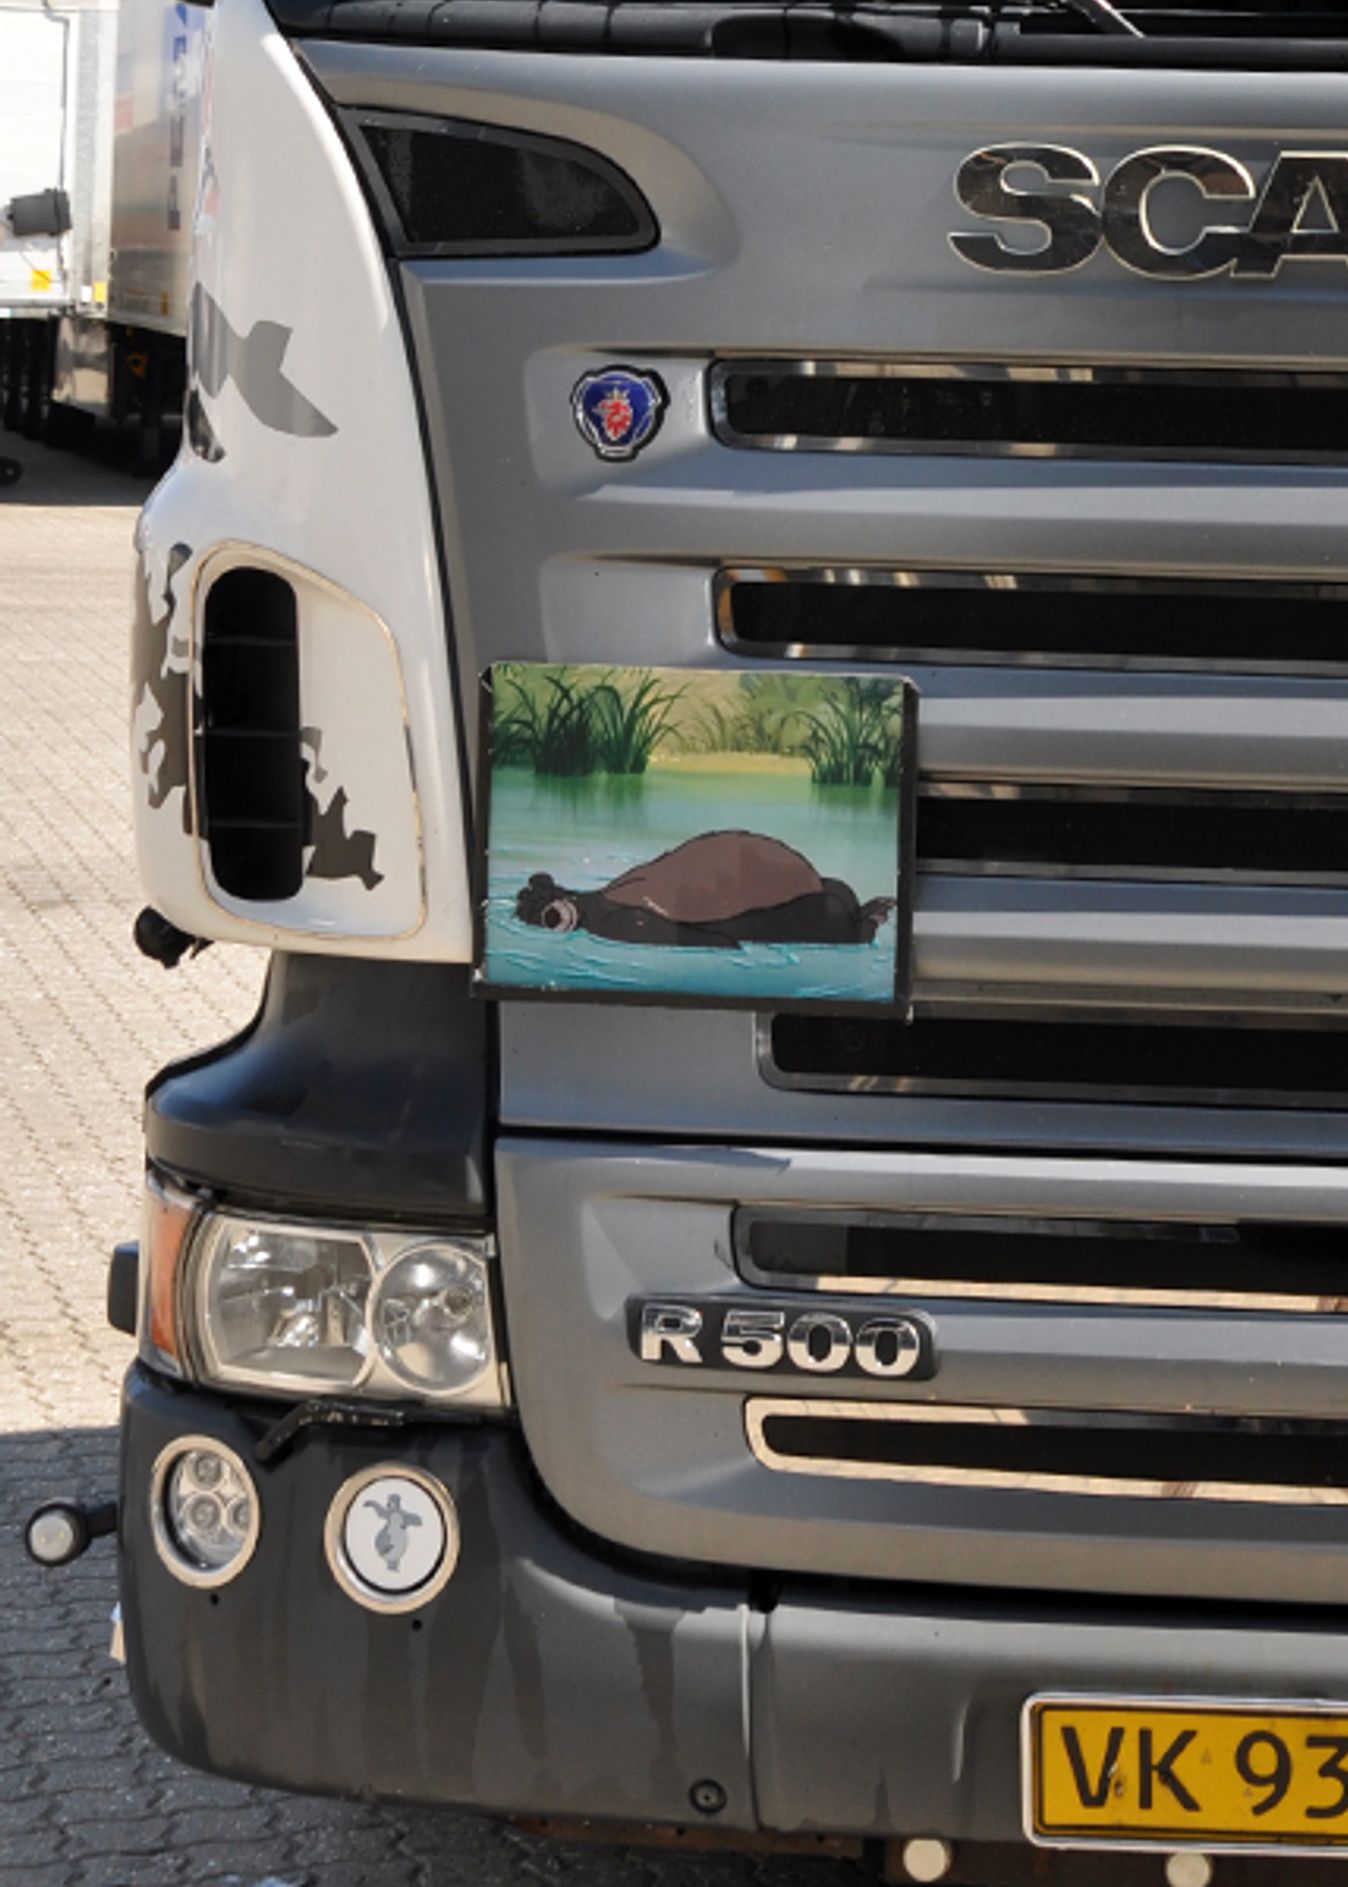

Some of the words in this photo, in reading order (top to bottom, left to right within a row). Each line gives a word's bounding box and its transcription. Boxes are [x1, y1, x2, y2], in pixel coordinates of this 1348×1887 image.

[641, 1303, 703, 1362] R
[721, 1308, 920, 1377] 500
[1060, 1725, 1201, 1811] VK
